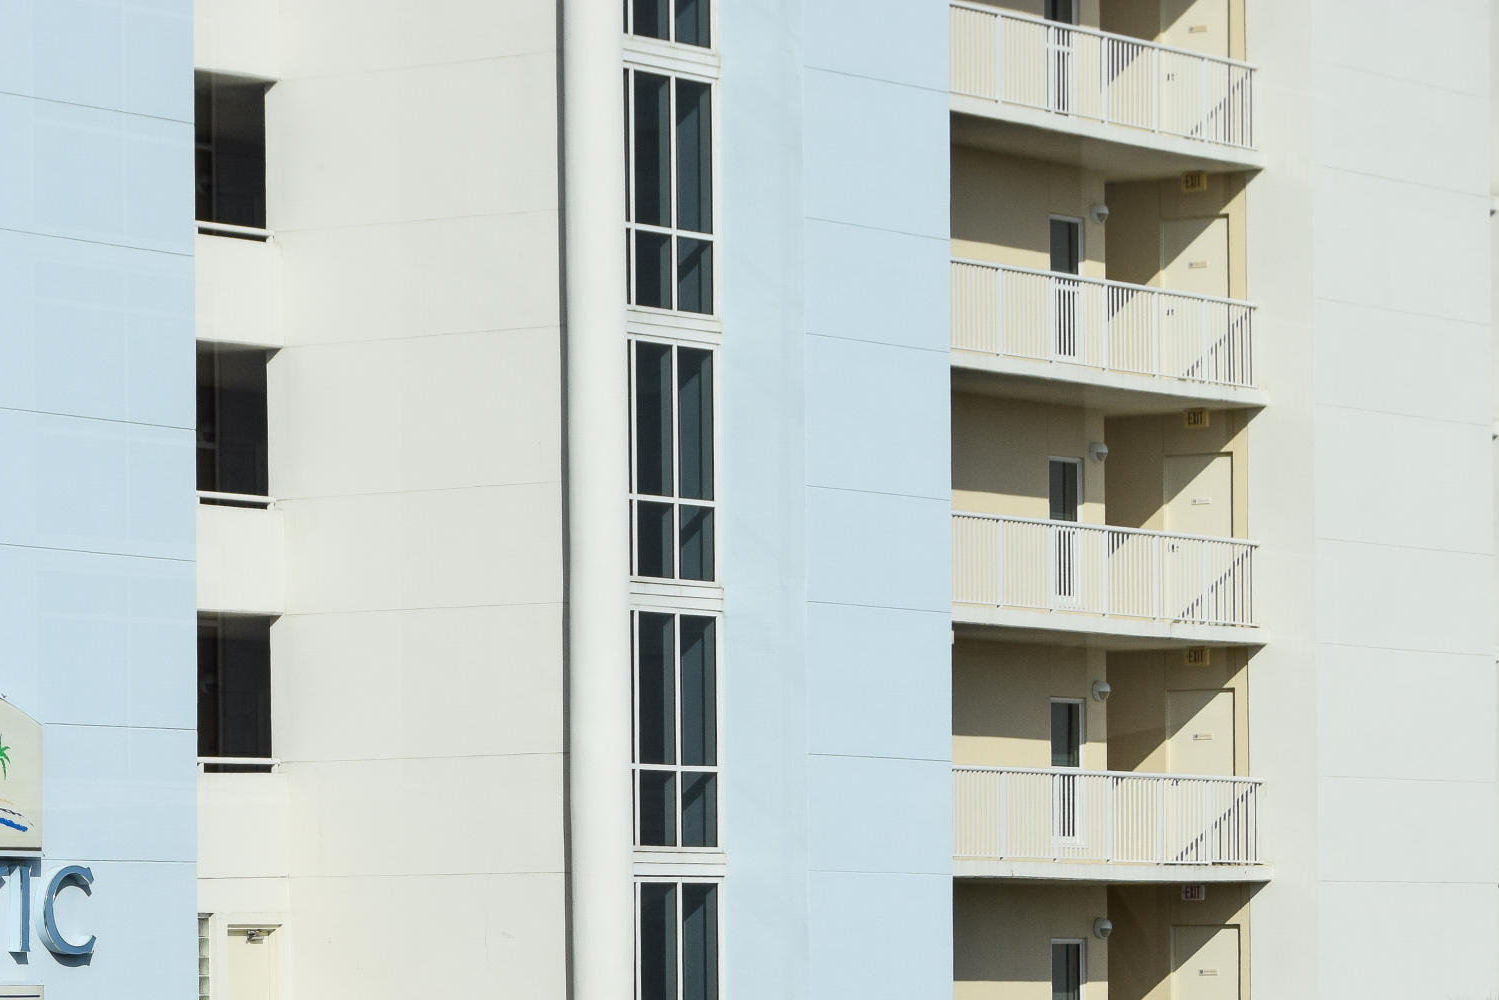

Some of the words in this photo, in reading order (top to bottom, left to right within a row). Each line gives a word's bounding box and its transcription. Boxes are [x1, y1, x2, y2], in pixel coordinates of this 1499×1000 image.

[1185, 174, 1201, 189] EXIT
[1187, 411, 1203, 425] EXIT
[1188, 649, 1204, 663] EXIT
[1184, 885, 1200, 899] EXIT
